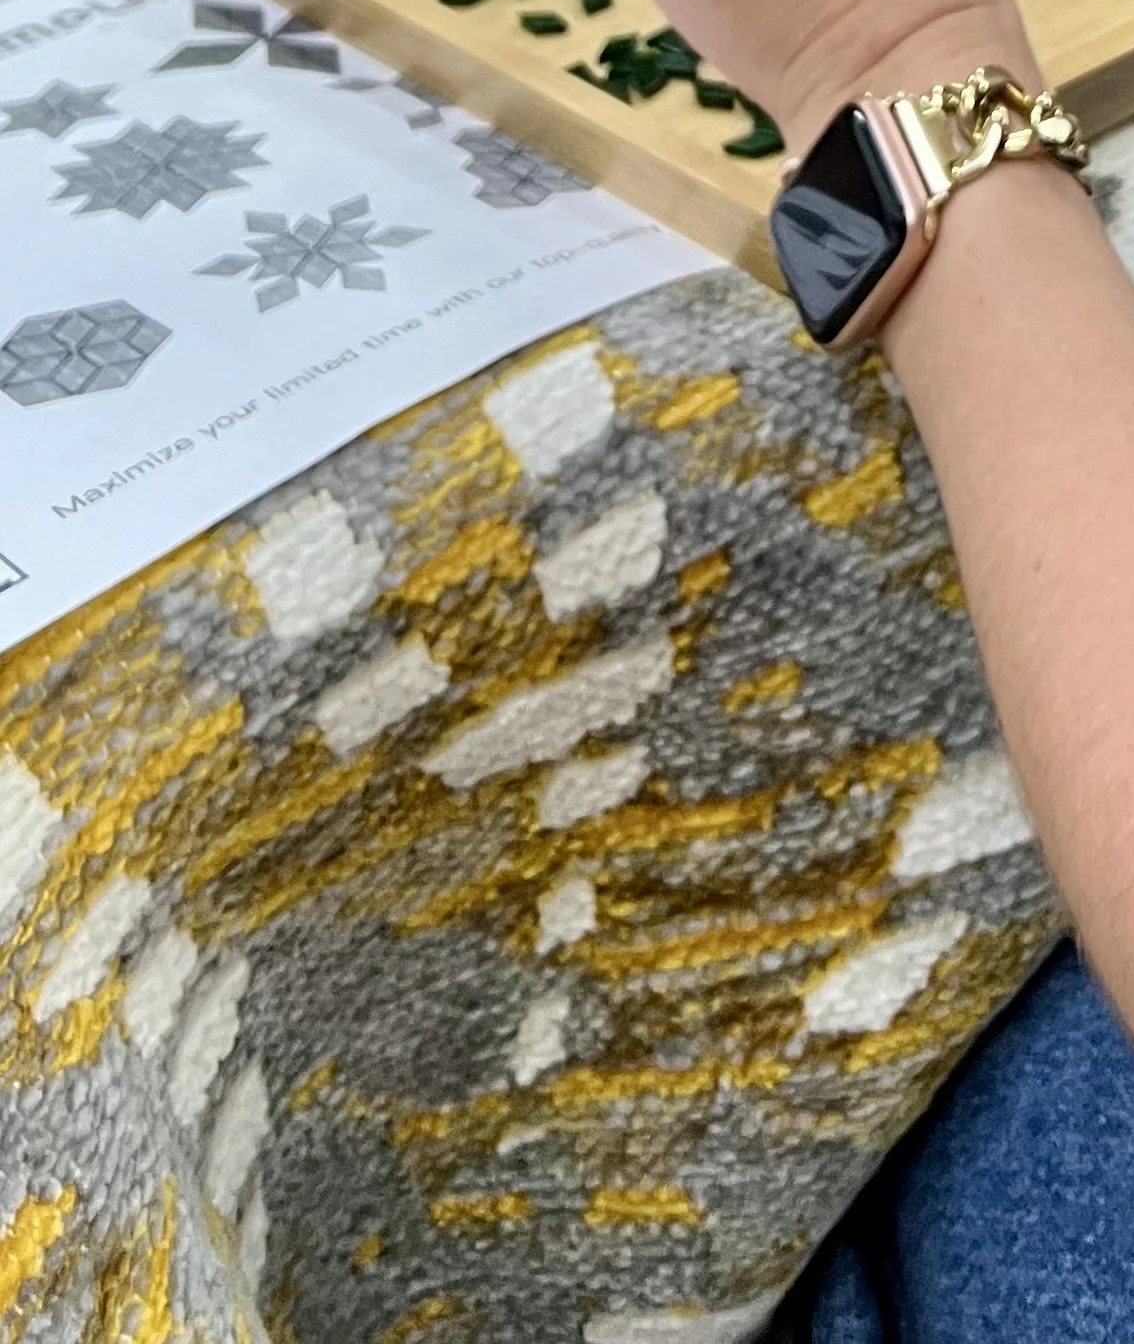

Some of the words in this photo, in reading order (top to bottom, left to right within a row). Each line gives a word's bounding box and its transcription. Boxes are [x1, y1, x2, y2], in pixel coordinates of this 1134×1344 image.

[51, 437, 196, 519] Maximize
[197, 398, 260, 442] your
[262, 348, 360, 402] limited
[361, 317, 423, 350] time
[425, 288, 486, 318] with
[485, 266, 525, 290] our
